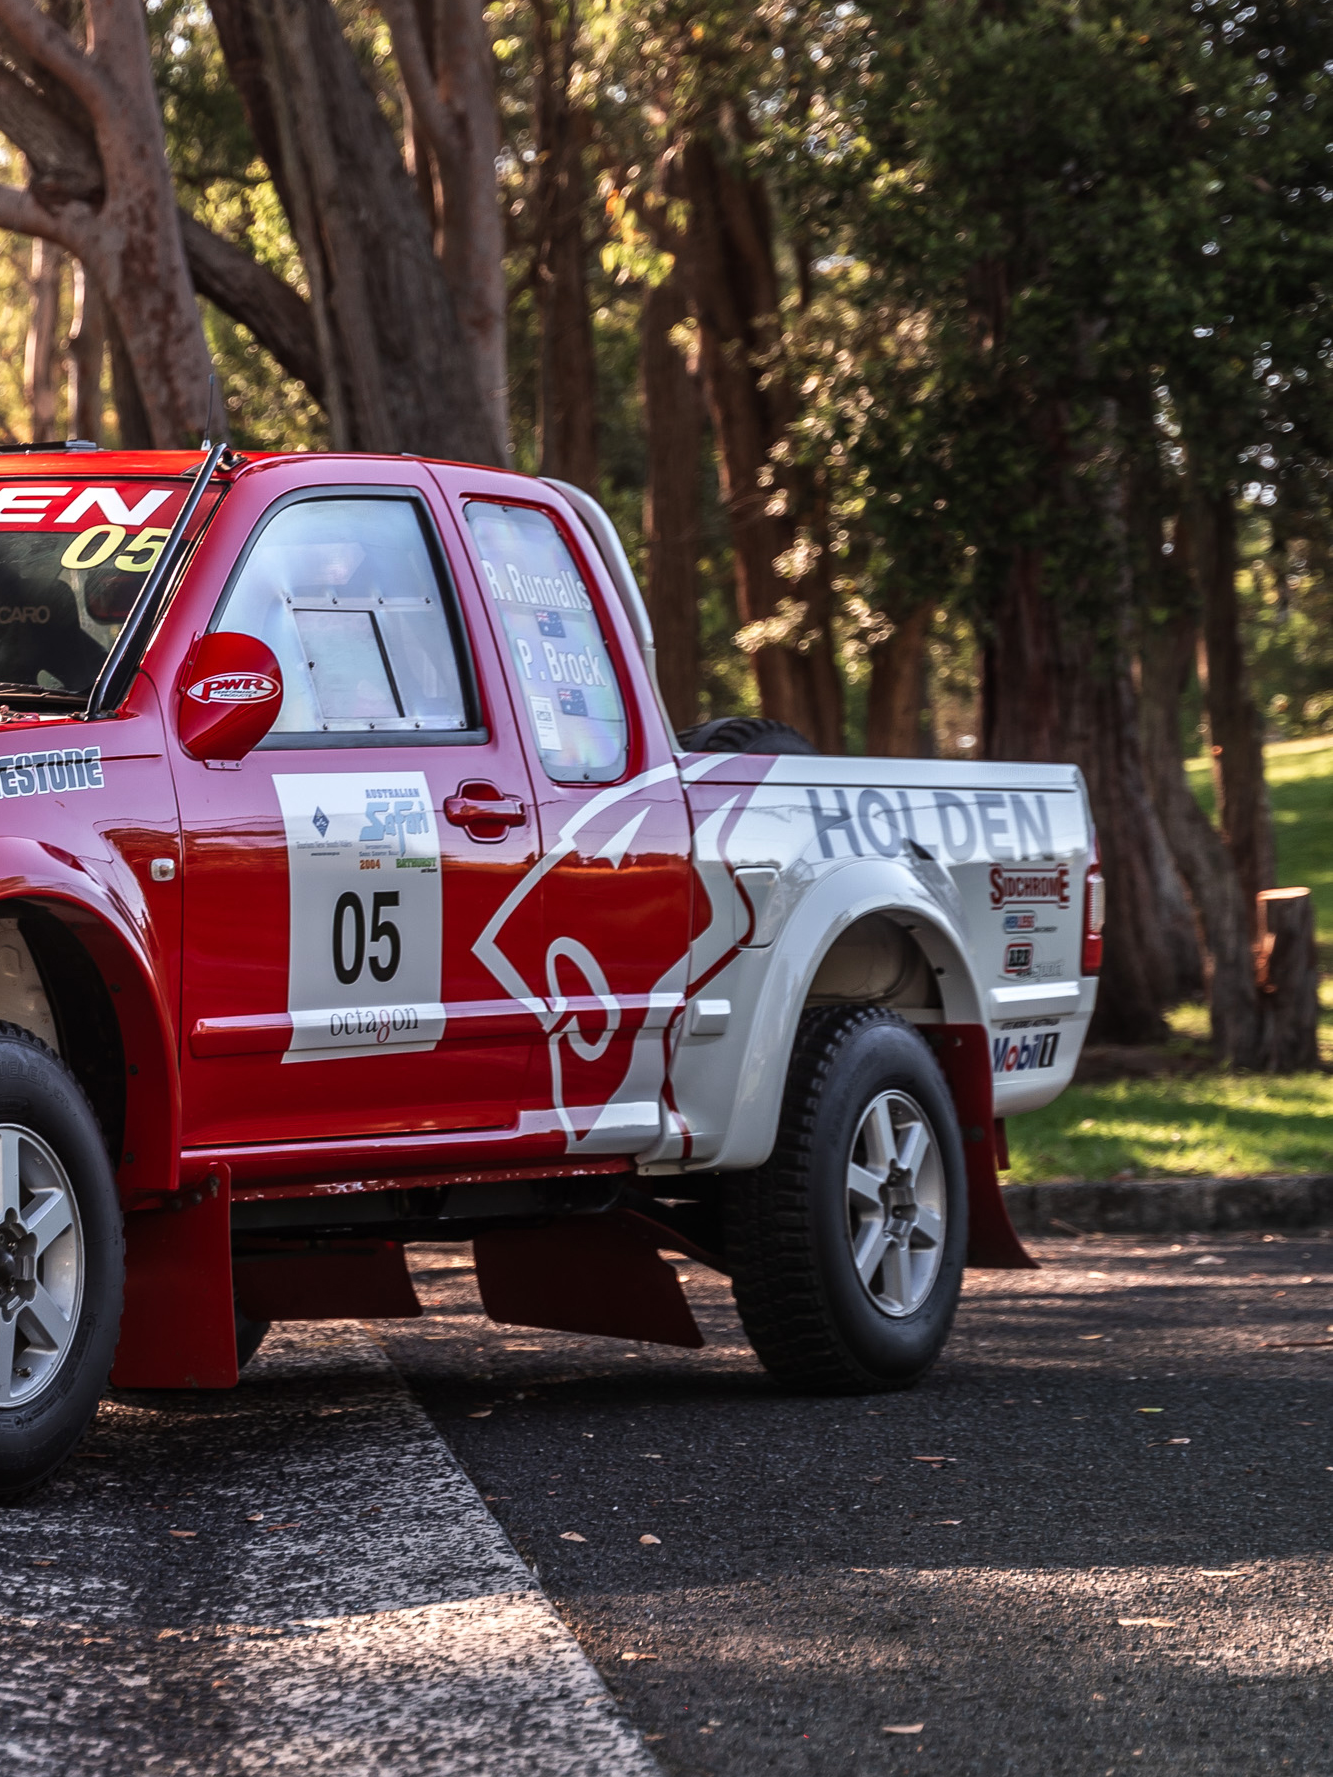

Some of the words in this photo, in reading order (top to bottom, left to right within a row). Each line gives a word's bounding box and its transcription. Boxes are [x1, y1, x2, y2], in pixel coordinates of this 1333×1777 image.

[60, 524, 173, 573] 05
[481, 559, 512, 601] R.
[506, 563, 592, 611] Runnalls
[542, 641, 606, 686] Brock
[202, 678, 272, 701] PWR
[365, 788, 420, 799] AUSTRALIAN
[806, 788, 1055, 862] HOLDEN
[360, 859, 381, 870] 2004
[989, 867, 1070, 906] SIDCHROME
[333, 891, 401, 985] 05
[329, 1007, 419, 1043] octagon
